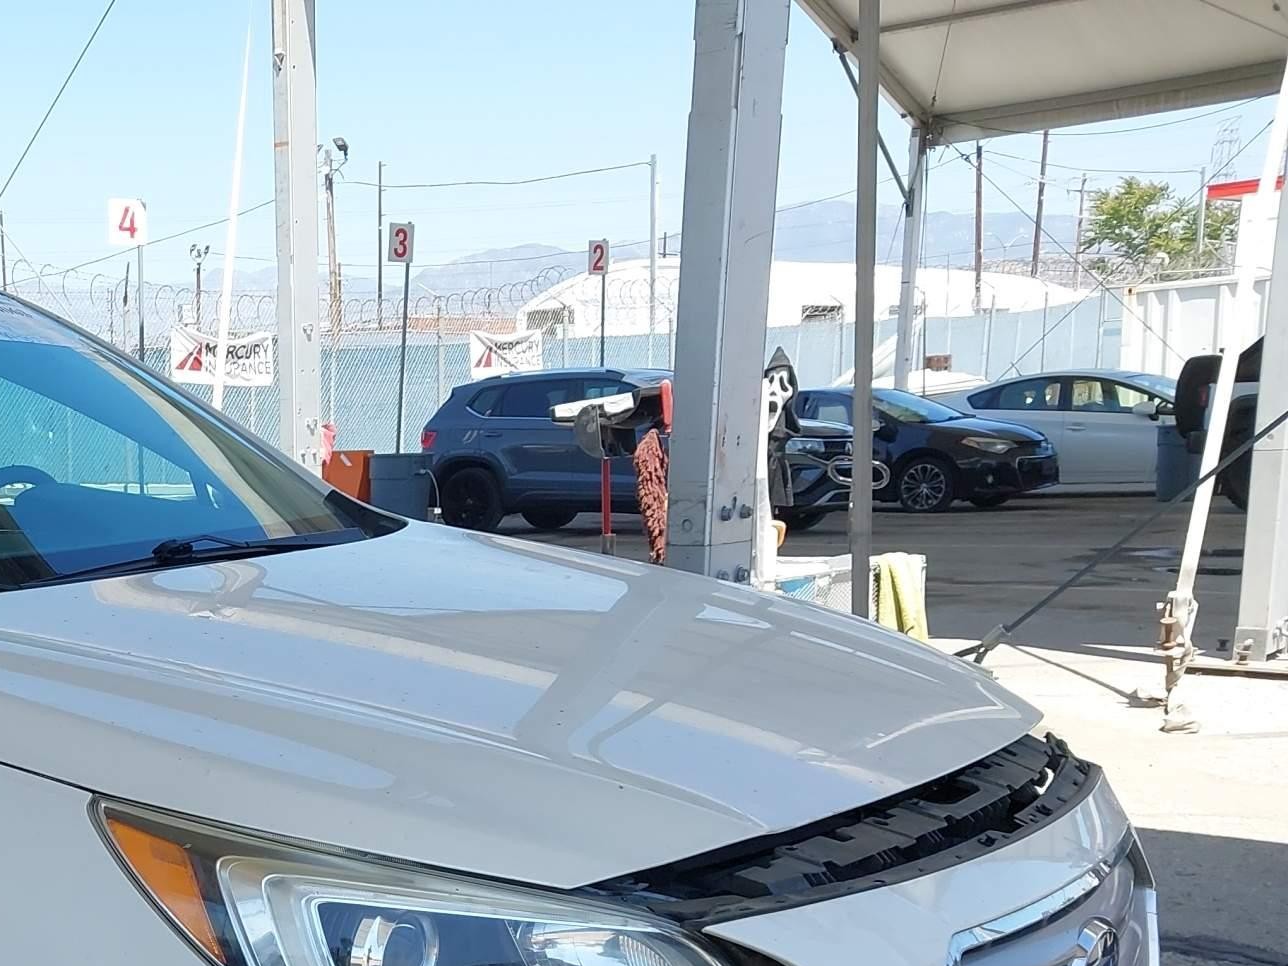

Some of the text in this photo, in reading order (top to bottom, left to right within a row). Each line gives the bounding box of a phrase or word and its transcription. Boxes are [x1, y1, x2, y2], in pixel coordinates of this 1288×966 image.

[118, 206, 138, 239] 4
[393, 227, 408, 258] 3
[592, 244, 604, 271] 2
[205, 342, 269, 360] MRCURY
[495, 354, 541, 368] INSRANCE
[205, 359, 271, 376] INURANCE
